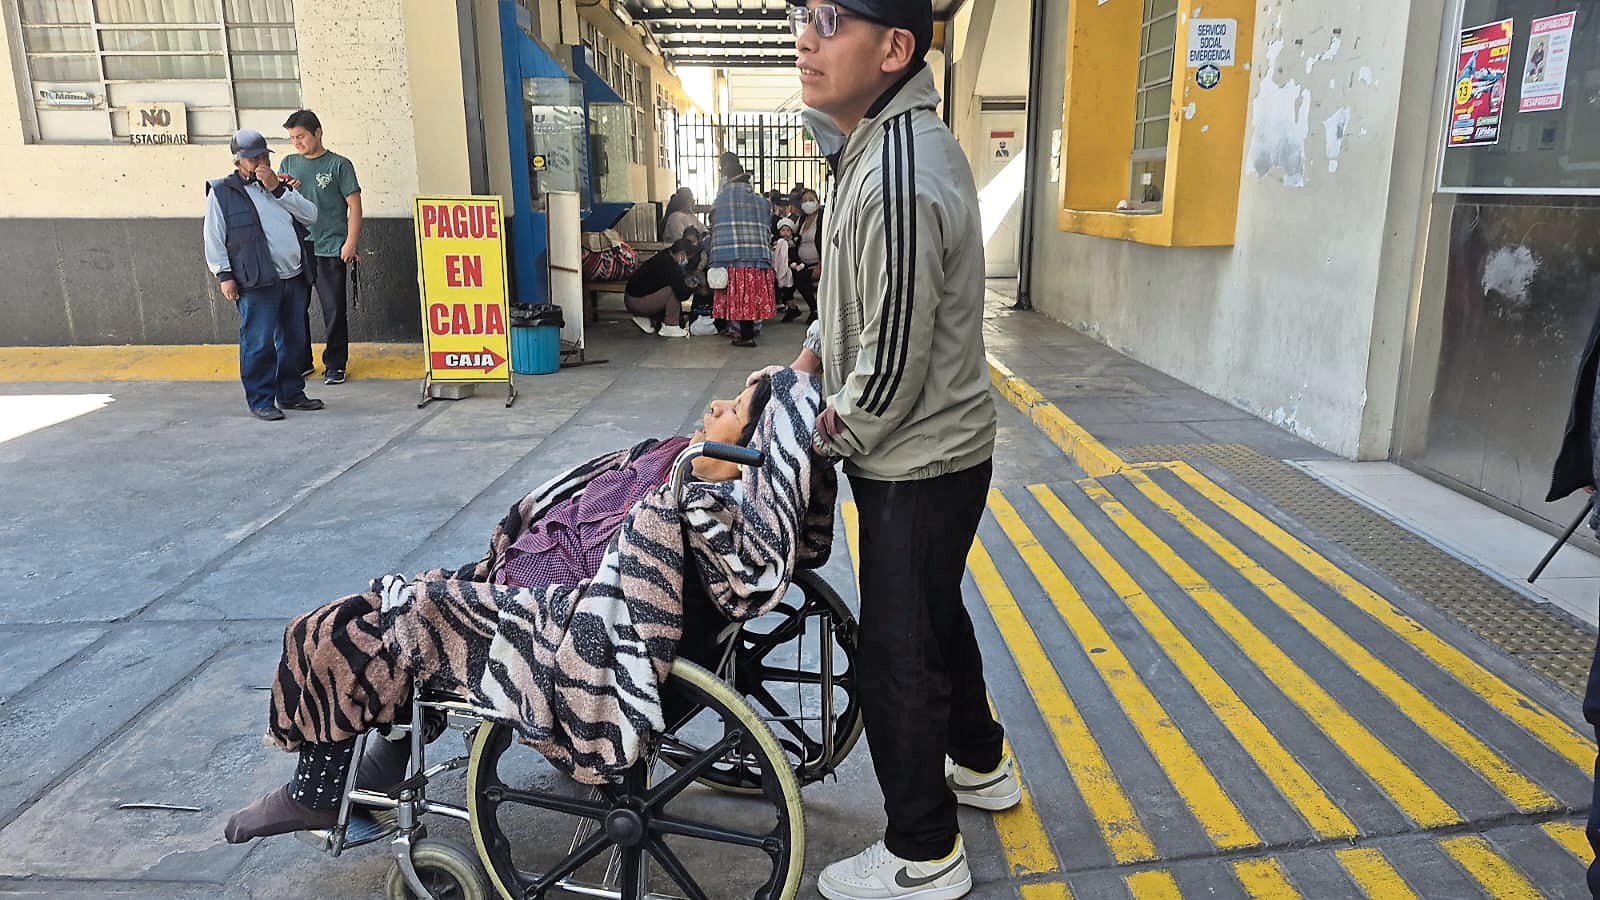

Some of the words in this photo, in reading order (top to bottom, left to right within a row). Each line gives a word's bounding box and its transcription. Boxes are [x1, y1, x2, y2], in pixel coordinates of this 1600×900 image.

[1198, 24, 1226, 36] SERVICIO
[1200, 37, 1222, 48] SOCIAL
[1189, 49, 1231, 61] EMERGENCIA
[140, 108, 171, 128] NO
[130, 133, 188, 145] ESTACIONAR
[422, 204, 498, 238] PAGUE
[445, 255, 483, 287] EN
[429, 303, 505, 335] CAJA
[445, 353, 495, 367] CAJA
